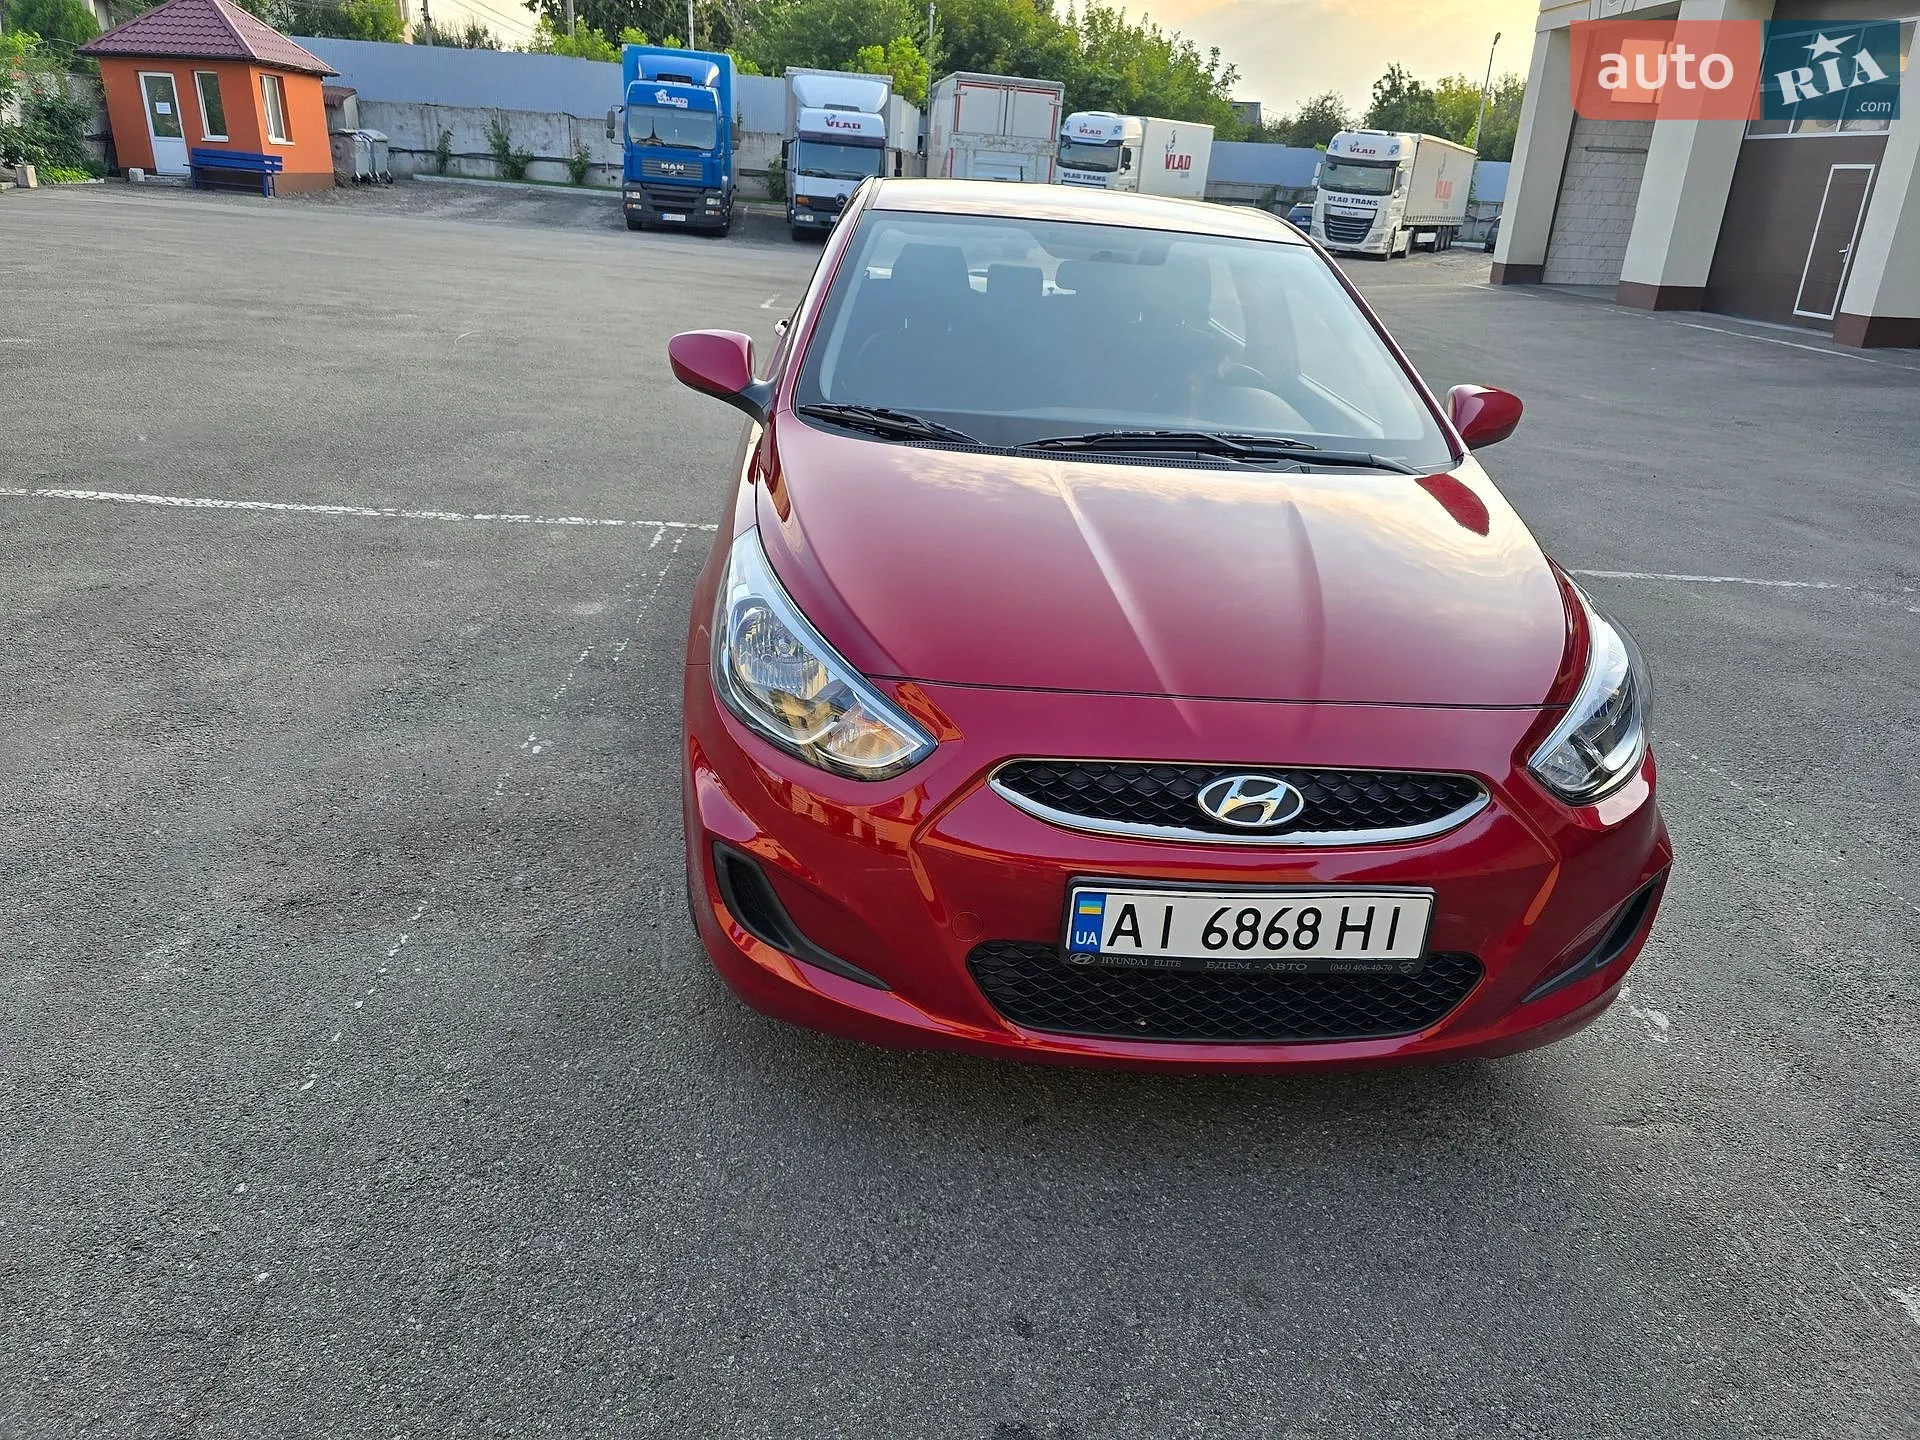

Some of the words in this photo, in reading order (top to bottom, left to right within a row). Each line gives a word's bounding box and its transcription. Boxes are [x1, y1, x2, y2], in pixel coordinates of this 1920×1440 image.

[825, 119, 861, 129] VLAD
[1349, 147, 1376, 155] VLAD
[660, 163, 685, 171] MAN
[1164, 153, 1192, 170] VLAD
[1327, 195, 1349, 204] VLAD
[1350, 197, 1378, 206] TRANS
[1106, 903, 1174, 949] AI
[1201, 906, 1323, 951] 6868
[1334, 906, 1401, 951] HI
[1075, 931, 1098, 946] UA
[1101, 957, 1149, 968] HYUNDAI
[1153, 959, 1182, 968] ELITE
[1204, 961, 1251, 971] ЕДЕМ
[1263, 962, 1308, 971] АВТО
